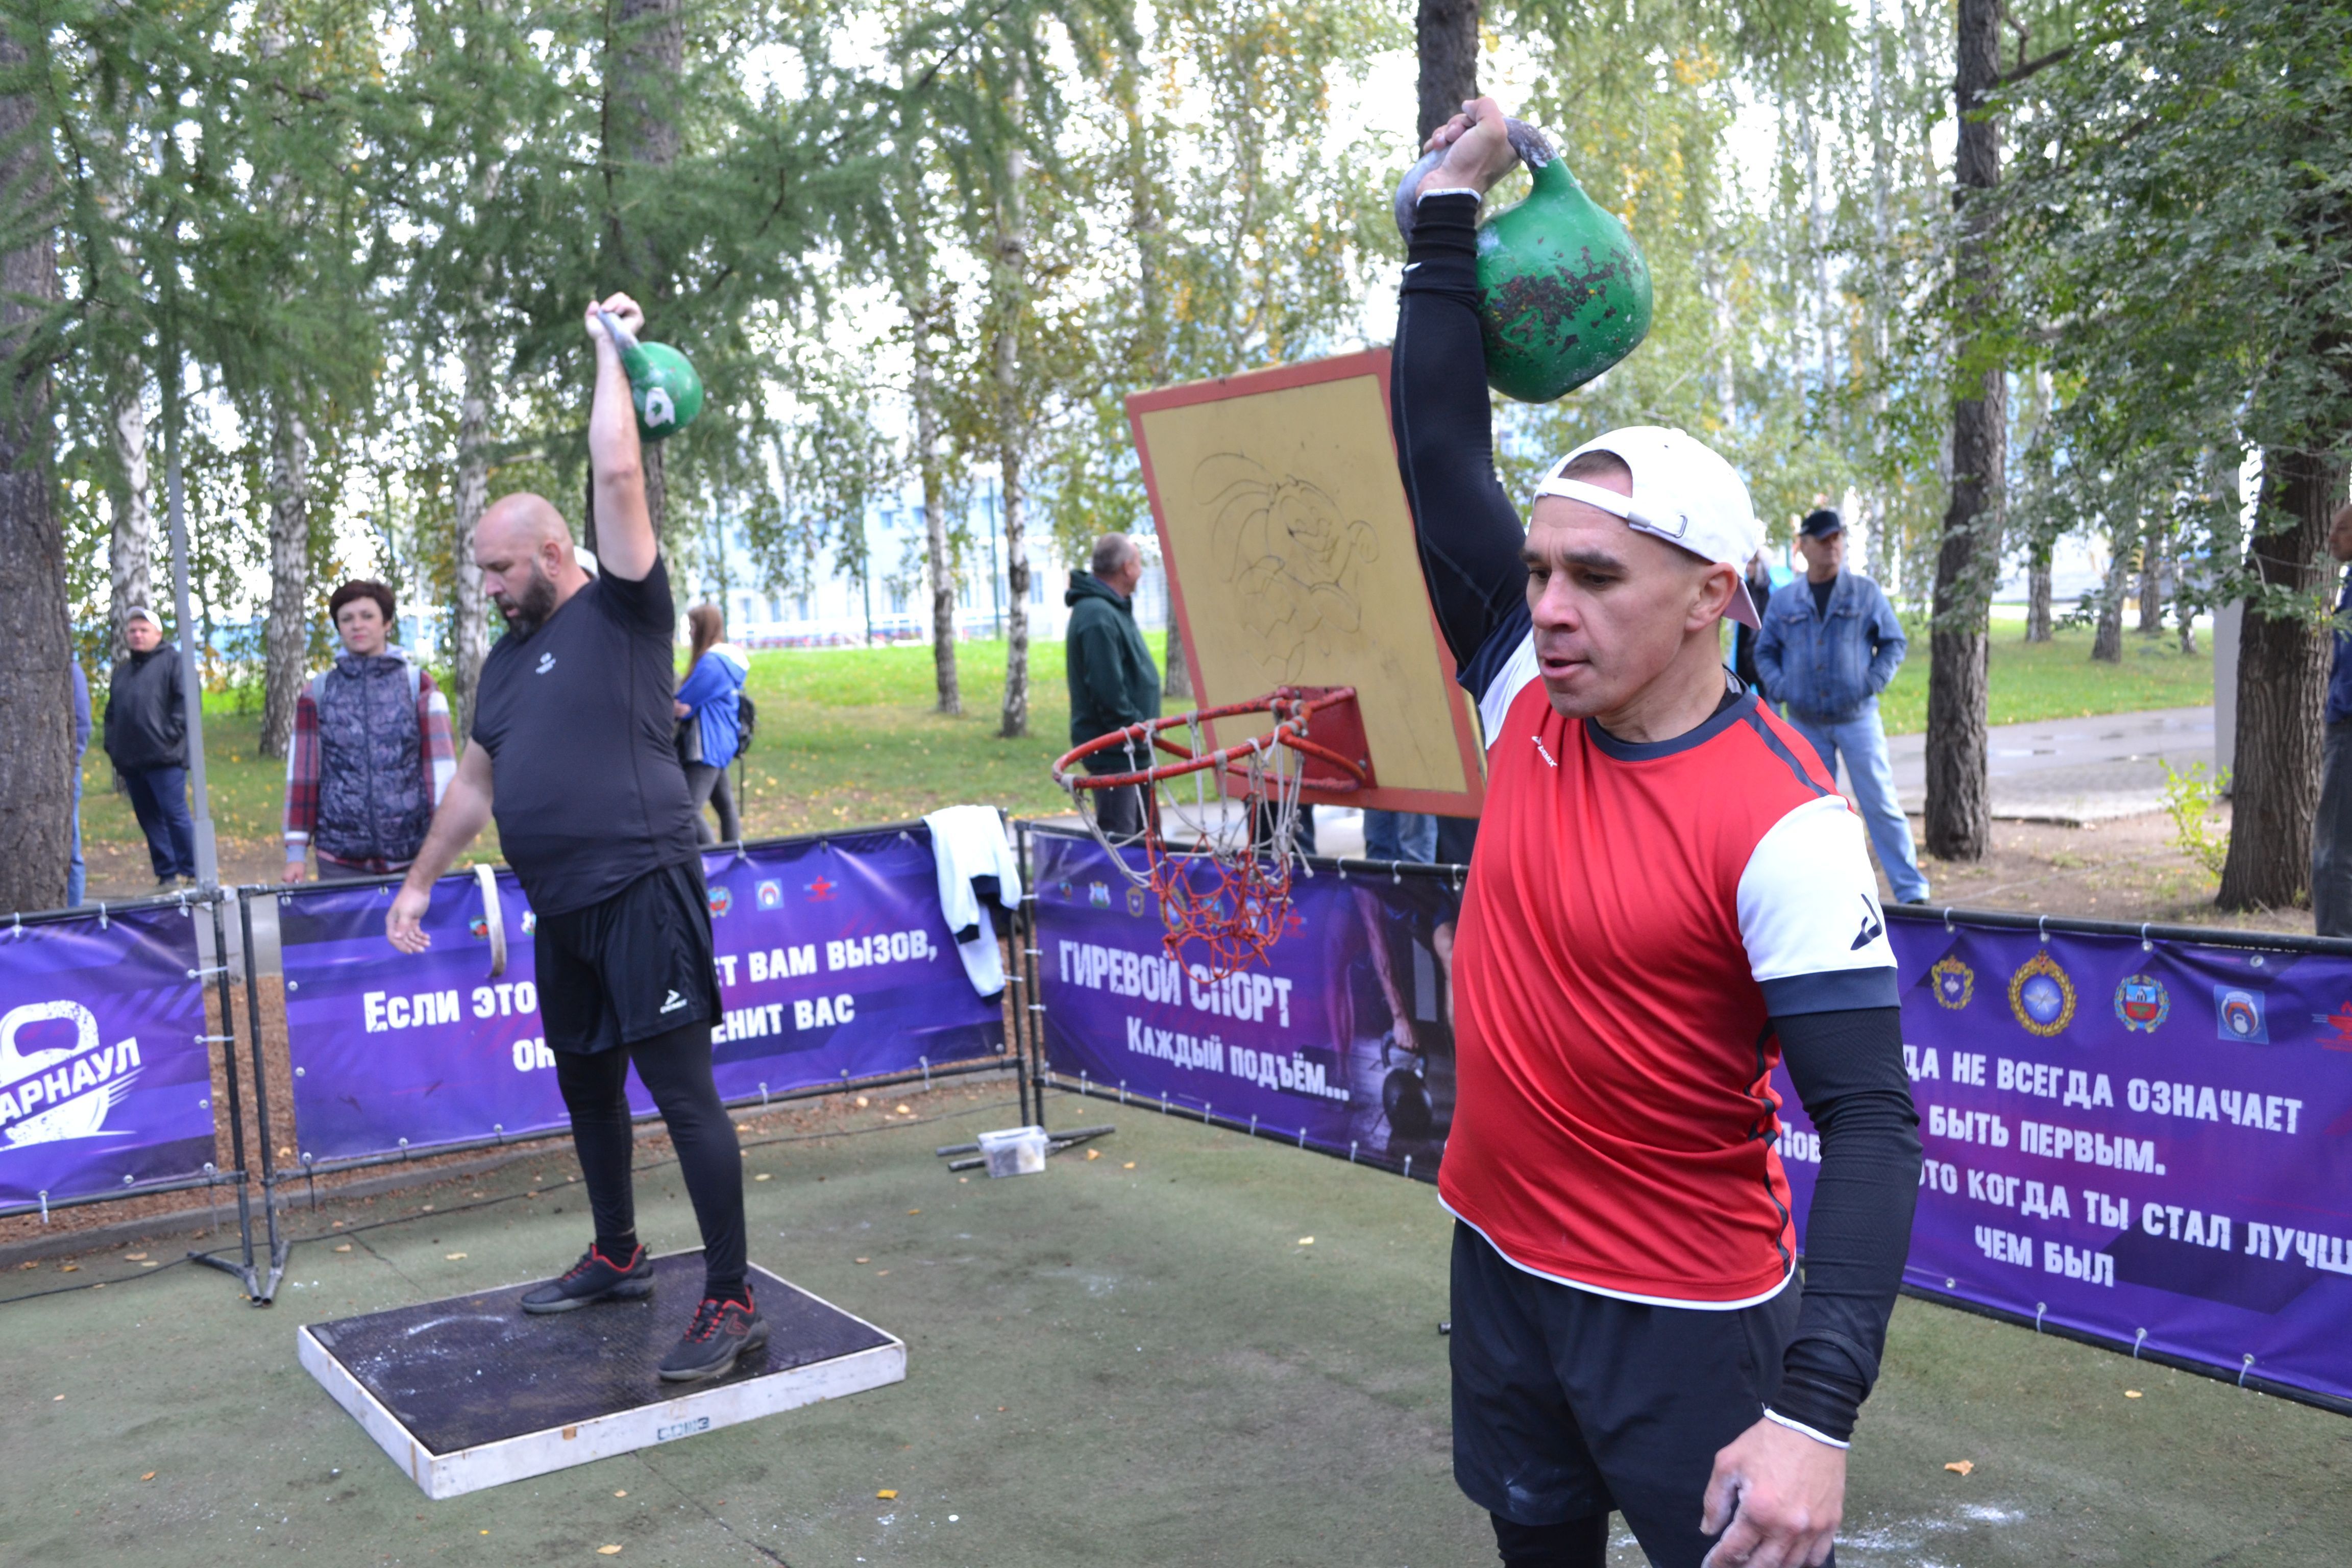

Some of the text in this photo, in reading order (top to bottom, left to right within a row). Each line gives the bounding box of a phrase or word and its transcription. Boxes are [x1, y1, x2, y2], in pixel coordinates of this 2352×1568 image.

[472, 981, 537, 1018] ЭТО
[748, 944, 817, 982] ВАМ
[826, 930, 937, 971] ВЫЗОВ,
[794, 994, 854, 1030] ВАС
[1059, 940, 1292, 1027] ГИРЕВОЙ СПОРТ
[1230, 1045, 1350, 1101] ПОДЪЁМ...
[1952, 1051, 1986, 1086] НЕ
[1997, 1058, 2114, 1110] ВСЕГДА
[2127, 1078, 2302, 1134] ОЗНАЧАЕТ
[1929, 1105, 2166, 1175] БЫТЬ ПЕРВЫМ.
[1967, 1169, 2070, 1220] КОГДА
[2083, 1190, 2128, 1230] ТЫ
[2142, 1203, 2231, 1251] СТАЛ
[2245, 1221, 2352, 1275] ЛУЧШ
[1975, 1225, 2114, 1287] ЧЕМ БЫЛ
